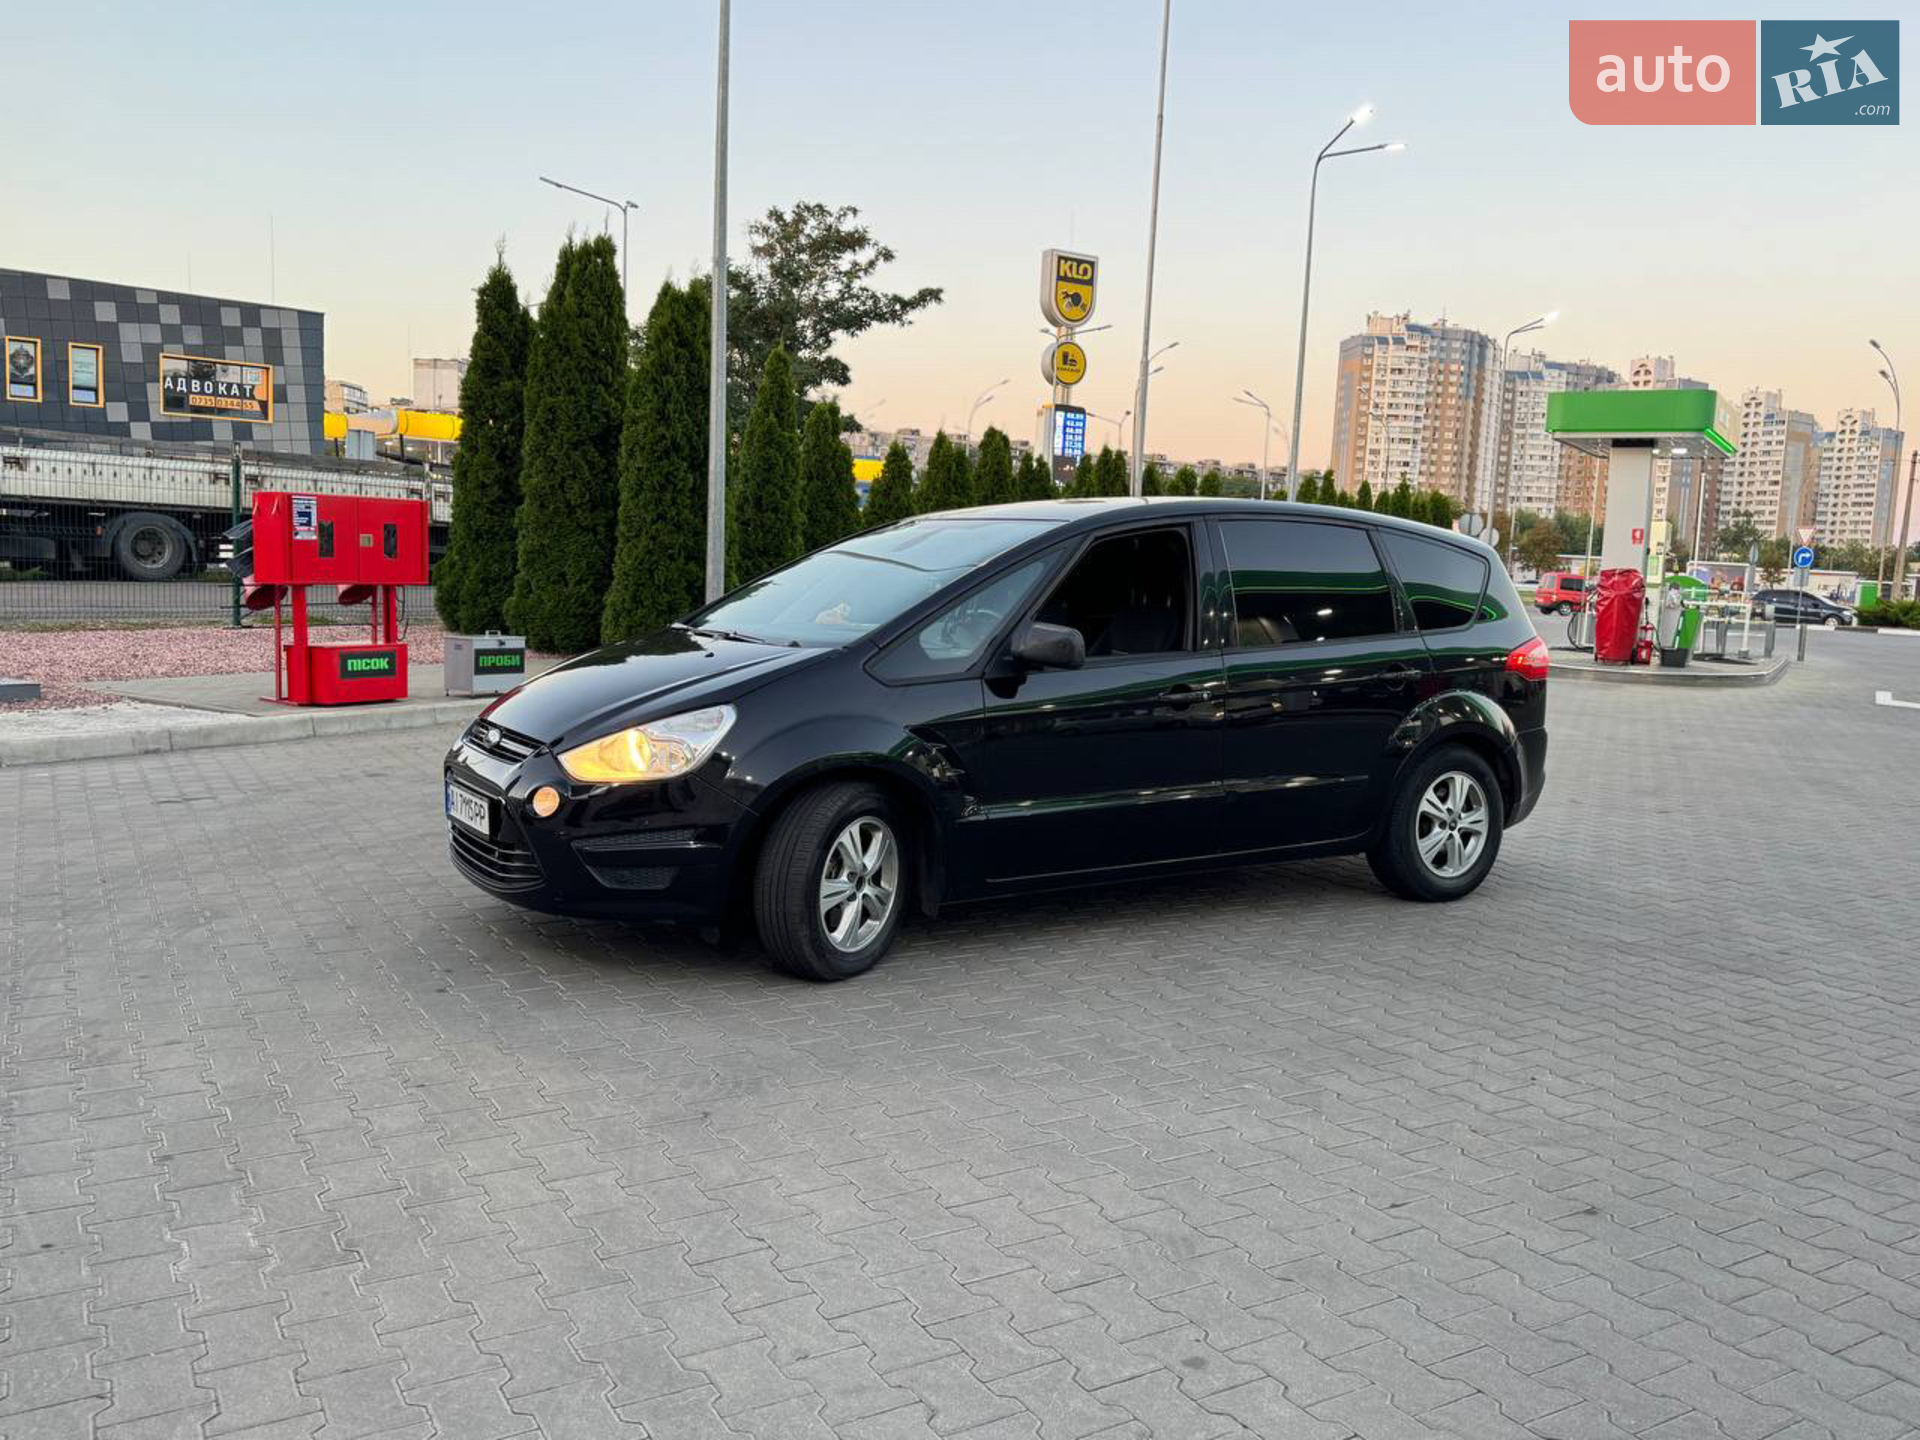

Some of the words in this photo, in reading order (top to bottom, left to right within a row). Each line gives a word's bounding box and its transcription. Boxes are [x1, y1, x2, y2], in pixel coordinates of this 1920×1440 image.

[1059, 259, 1092, 280] KLO
[164, 377, 252, 398] АДВОКАТ
[347, 657, 389, 671] ПІСОК
[479, 654, 521, 667] ПРОБИ
